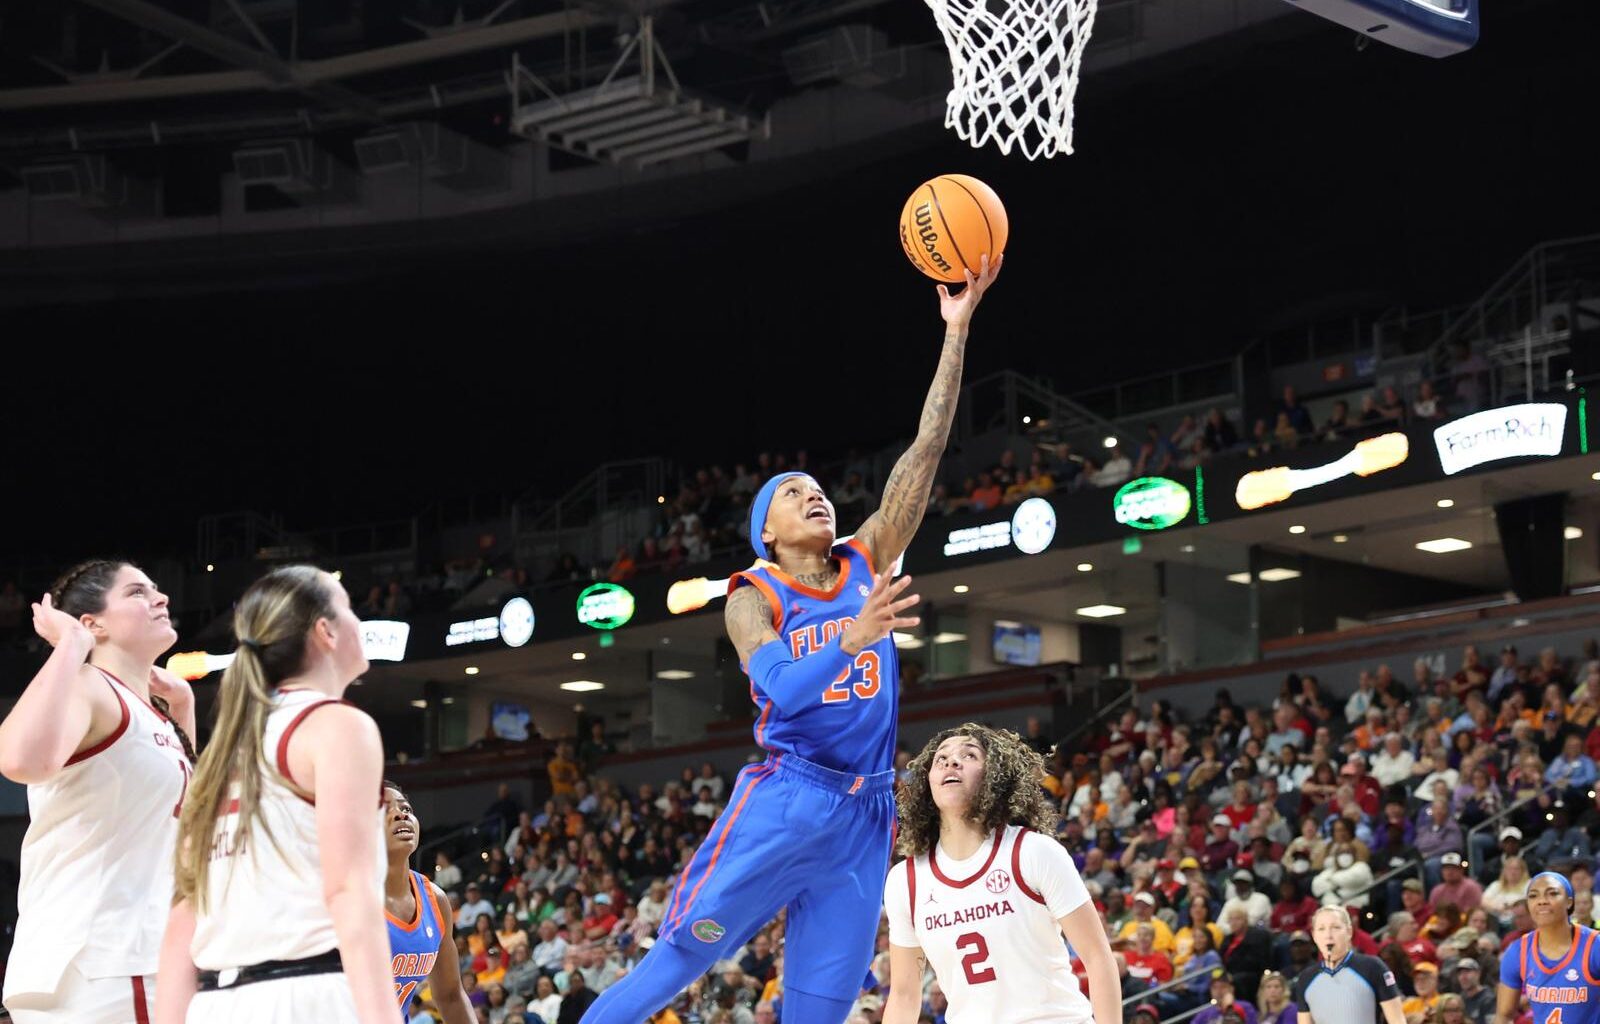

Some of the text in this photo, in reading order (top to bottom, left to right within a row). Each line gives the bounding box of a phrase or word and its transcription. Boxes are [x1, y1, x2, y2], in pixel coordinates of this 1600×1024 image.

[914, 202, 952, 273] Wilson
[822, 650, 881, 704] 23
[847, 776, 865, 795] F
[985, 869, 1010, 894] SEC
[925, 900, 1015, 931] OKLAHOMA
[391, 951, 439, 977] ORID
[955, 931, 997, 985] 2
[1525, 983, 1588, 1004] FLORIDA
